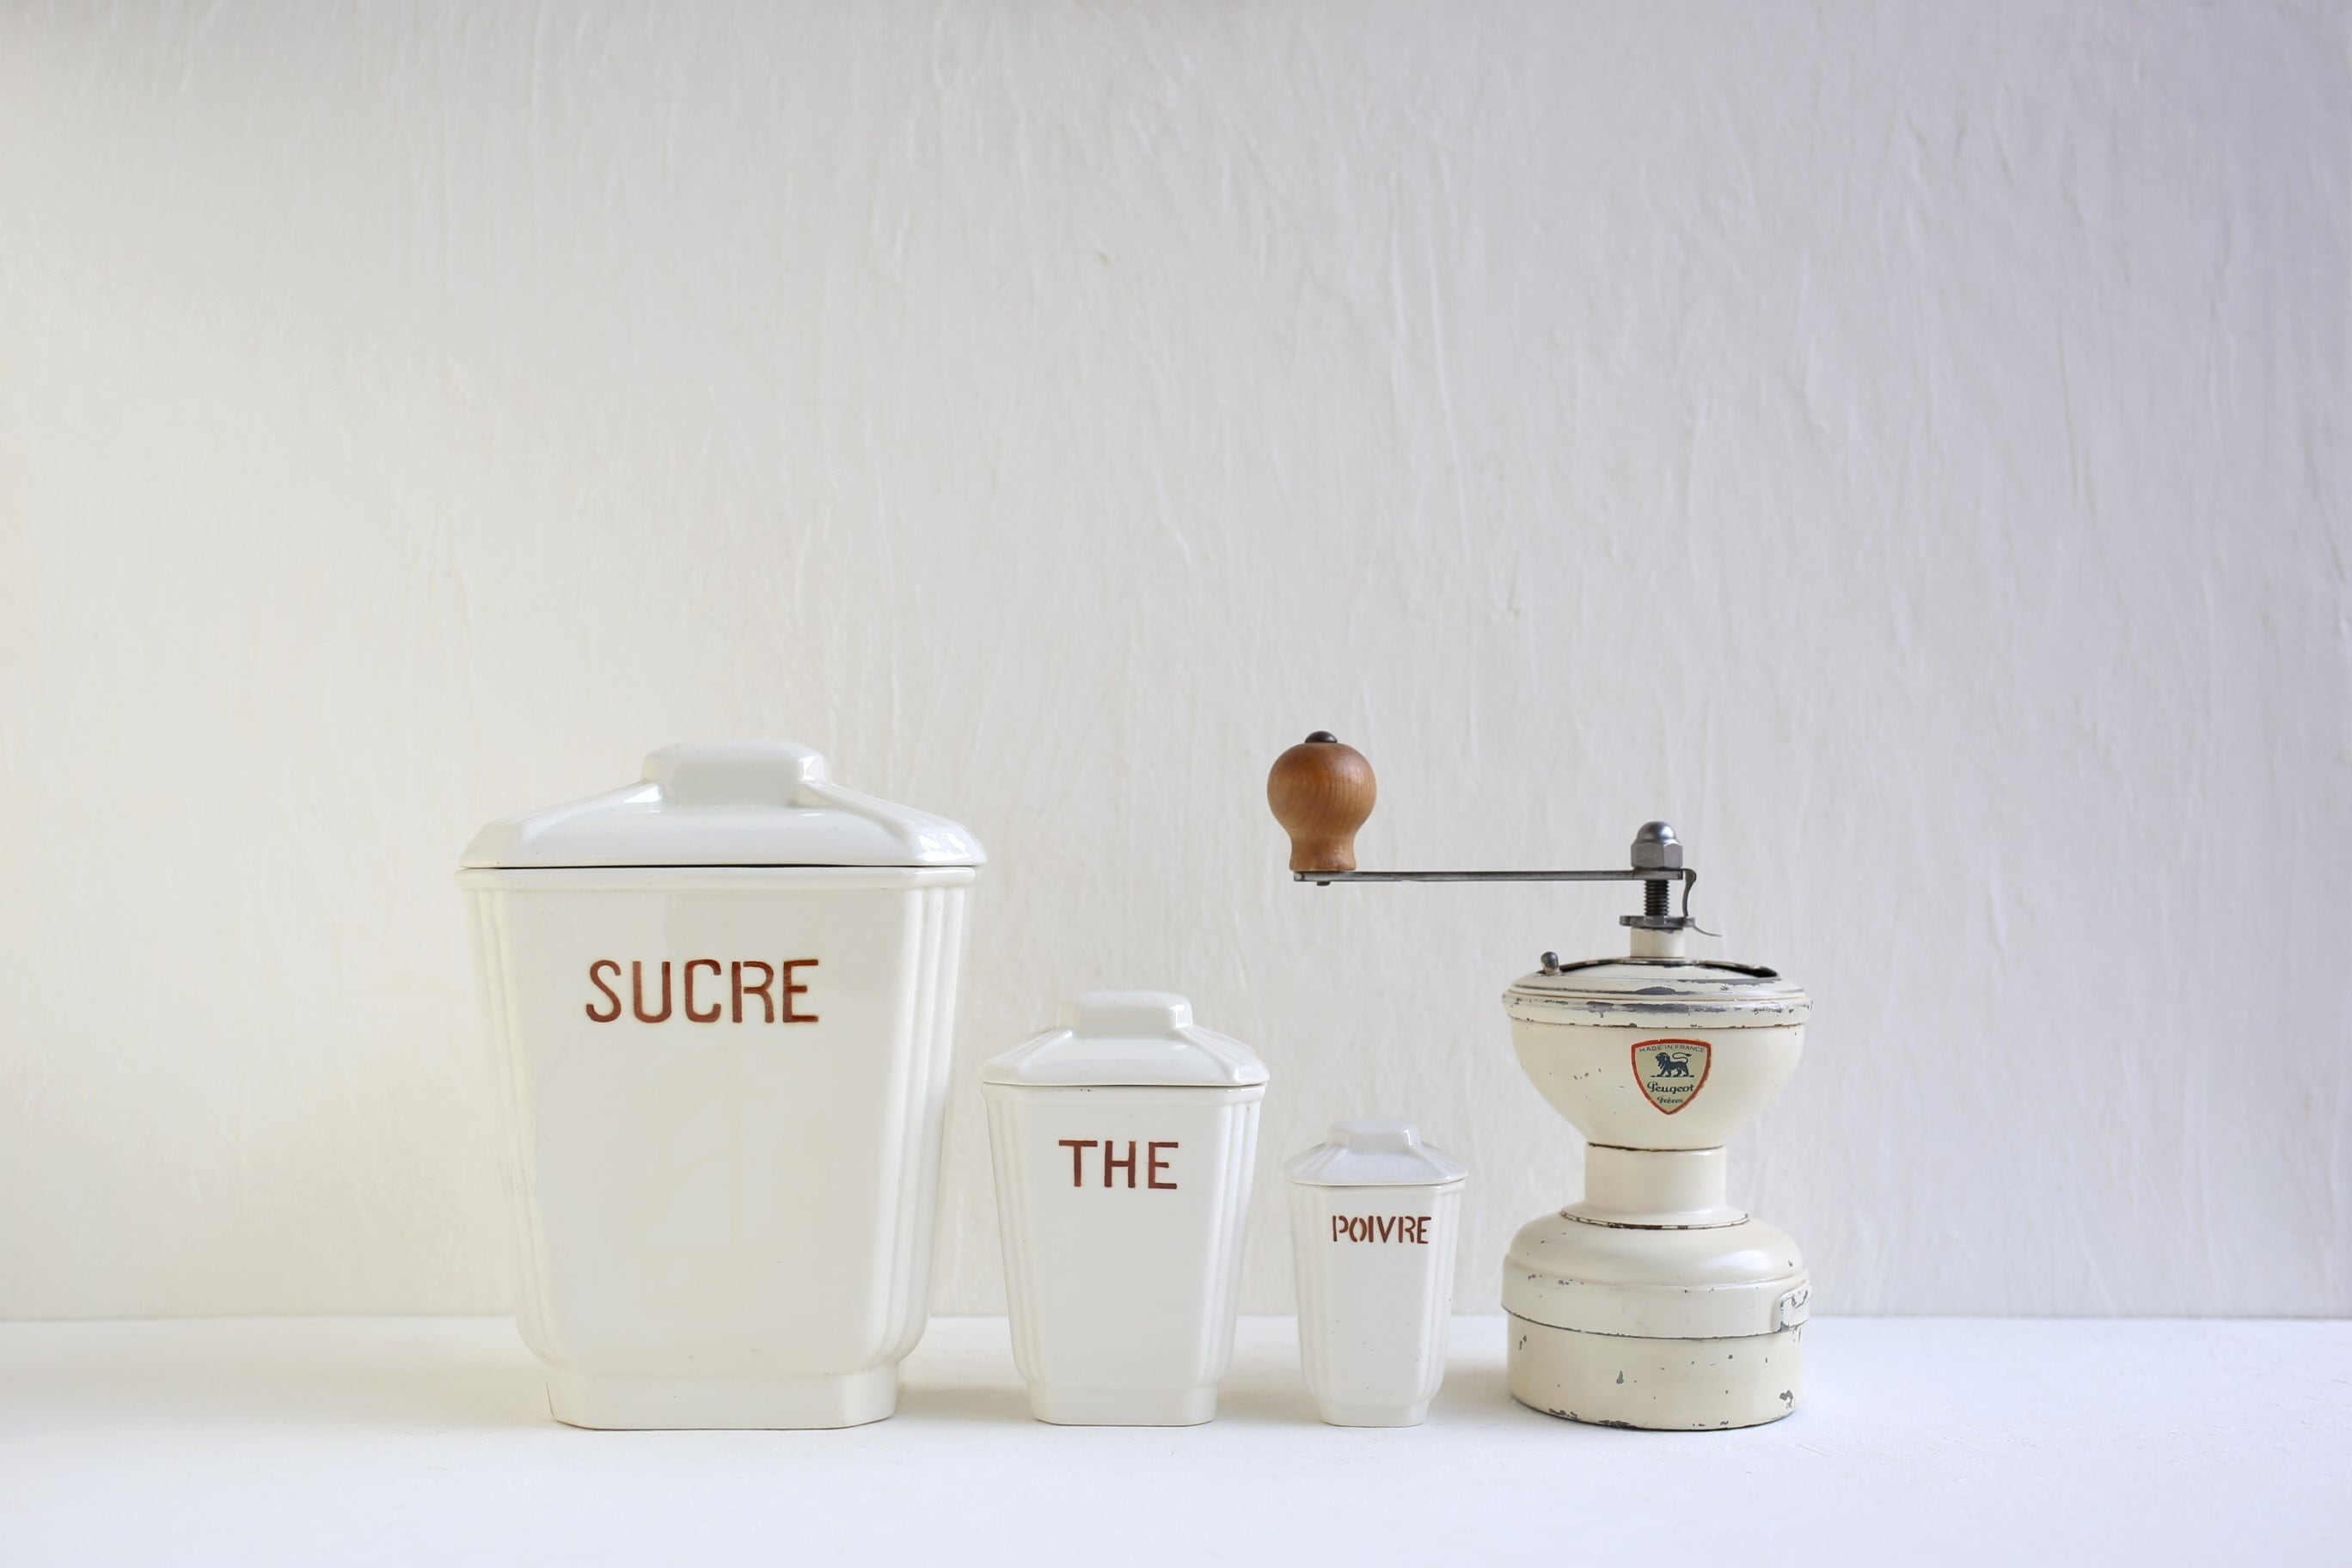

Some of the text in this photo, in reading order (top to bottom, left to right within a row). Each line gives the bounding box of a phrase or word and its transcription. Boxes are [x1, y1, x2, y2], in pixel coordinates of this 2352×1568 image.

[585, 958, 820, 1024] SUCRE
[1638, 1044, 1663, 1053] MADE
[1675, 1044, 1705, 1053] FRANCE
[1647, 1081, 1694, 1094] Peugeot
[1058, 1140, 1179, 1189] THE
[1332, 1216, 1431, 1245] POIVRE
